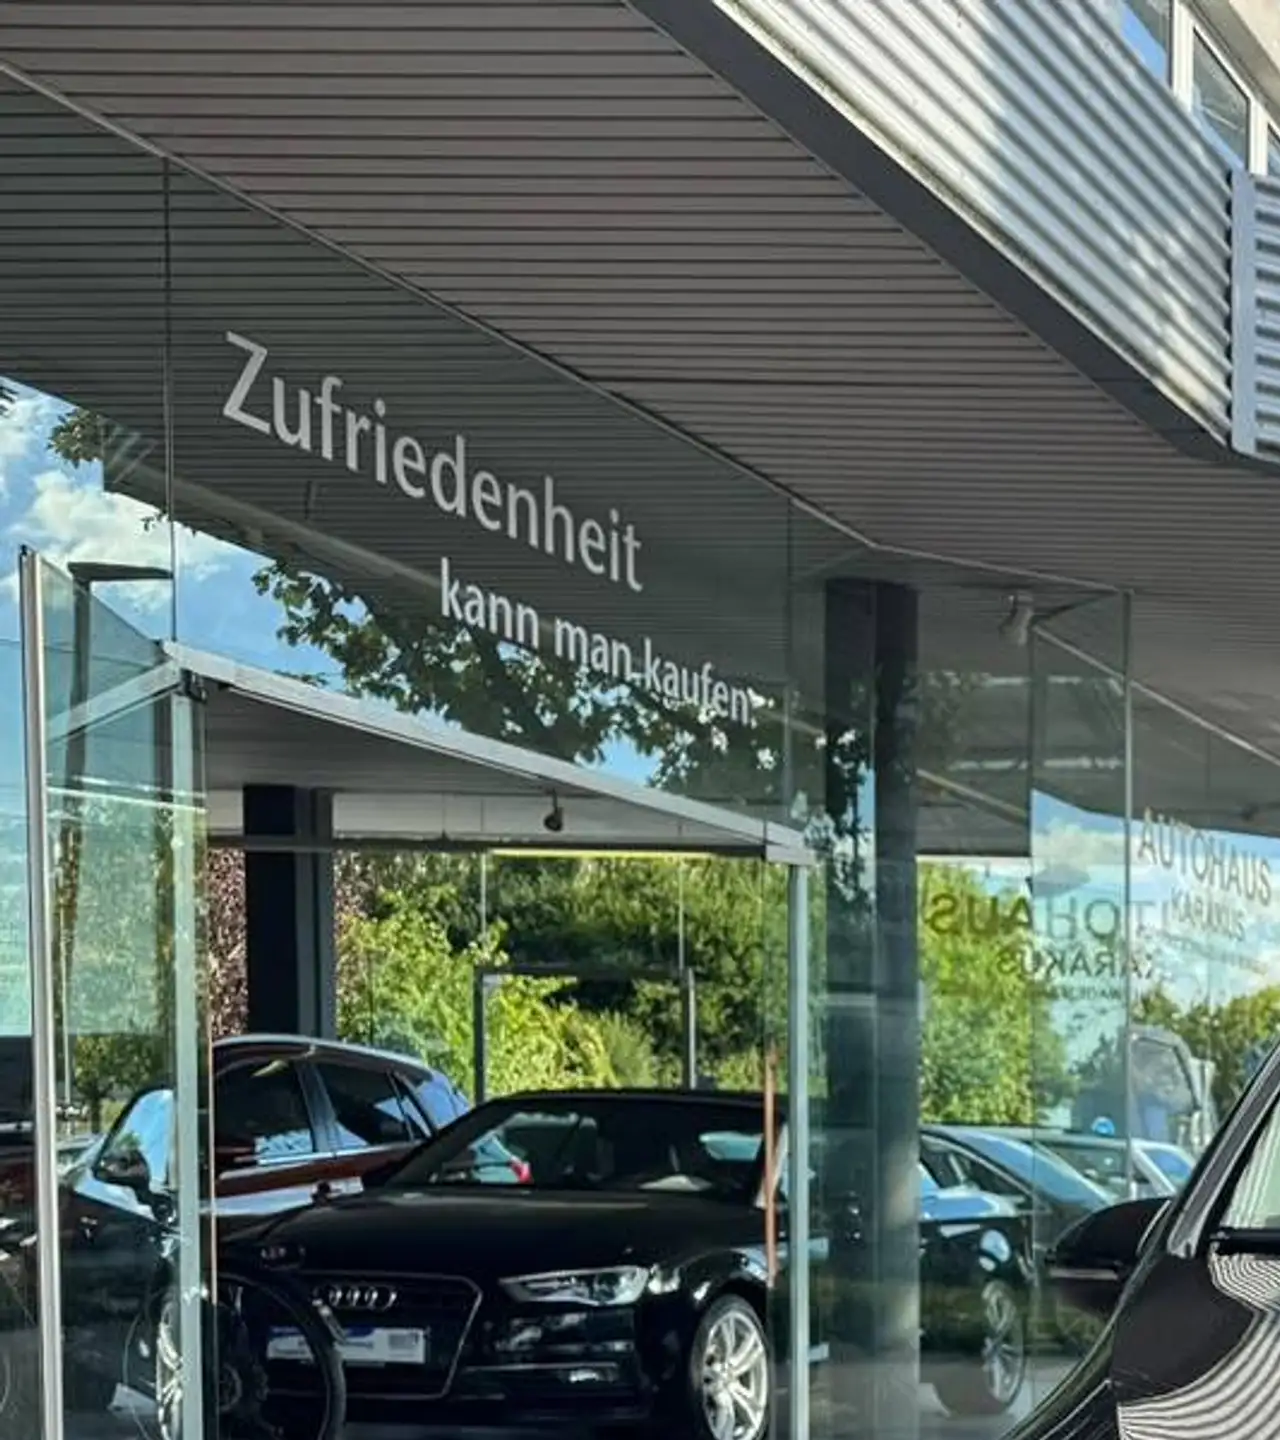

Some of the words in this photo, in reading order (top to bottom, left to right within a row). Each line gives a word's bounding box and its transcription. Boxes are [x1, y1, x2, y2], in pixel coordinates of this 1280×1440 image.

[222, 331, 643, 592] Zufriedenheit
[441, 556, 539, 650] kann
[554, 615, 632, 683] man
[1137, 806, 1272, 907] AUTOHAUS
